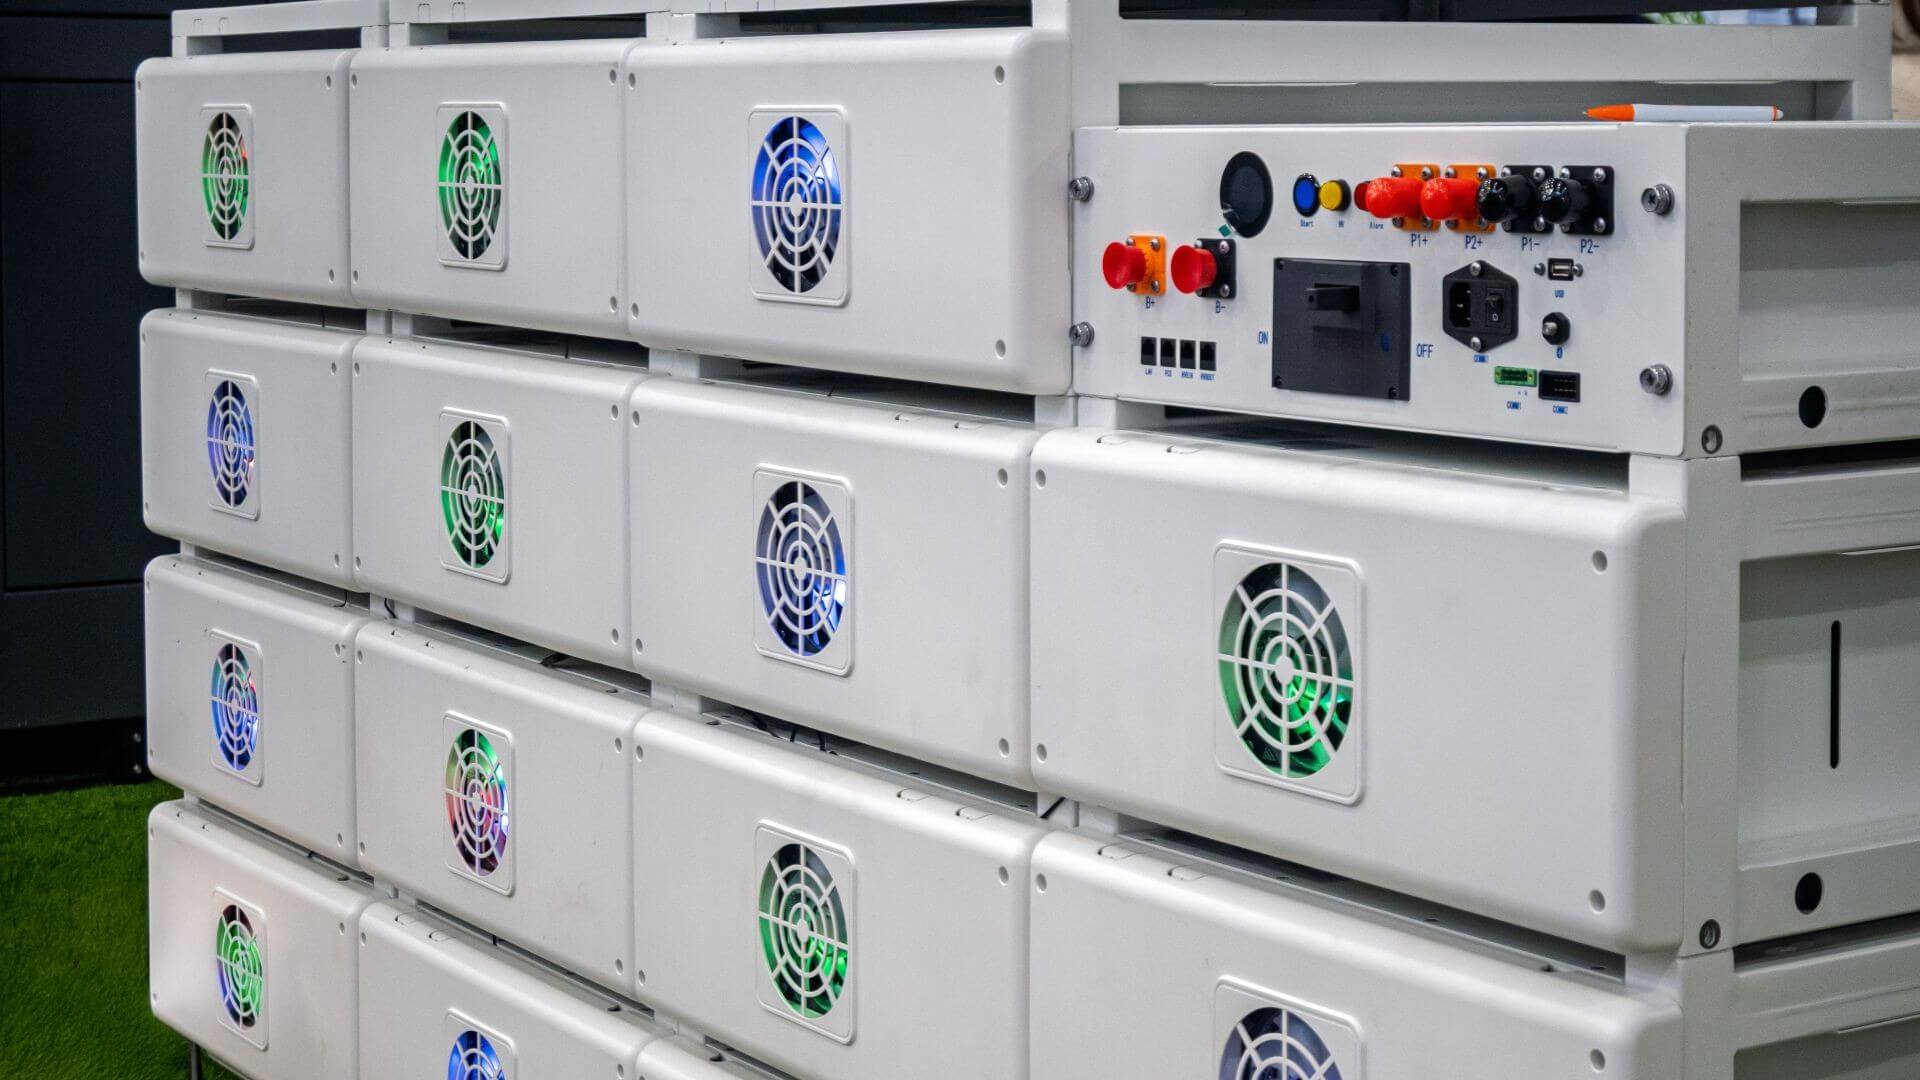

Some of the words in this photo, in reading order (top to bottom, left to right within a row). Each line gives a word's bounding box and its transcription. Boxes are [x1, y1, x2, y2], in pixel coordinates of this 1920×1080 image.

[1410, 233, 1429, 247] P1+
[1465, 235, 1483, 249] P2+
[1521, 237, 1540, 251] P1-
[1580, 240, 1600, 253] P2-
[1145, 296, 1155, 309] B+
[1215, 300, 1226, 313] B-
[1258, 331, 1269, 344] ON
[1416, 344, 1433, 358] OFF
